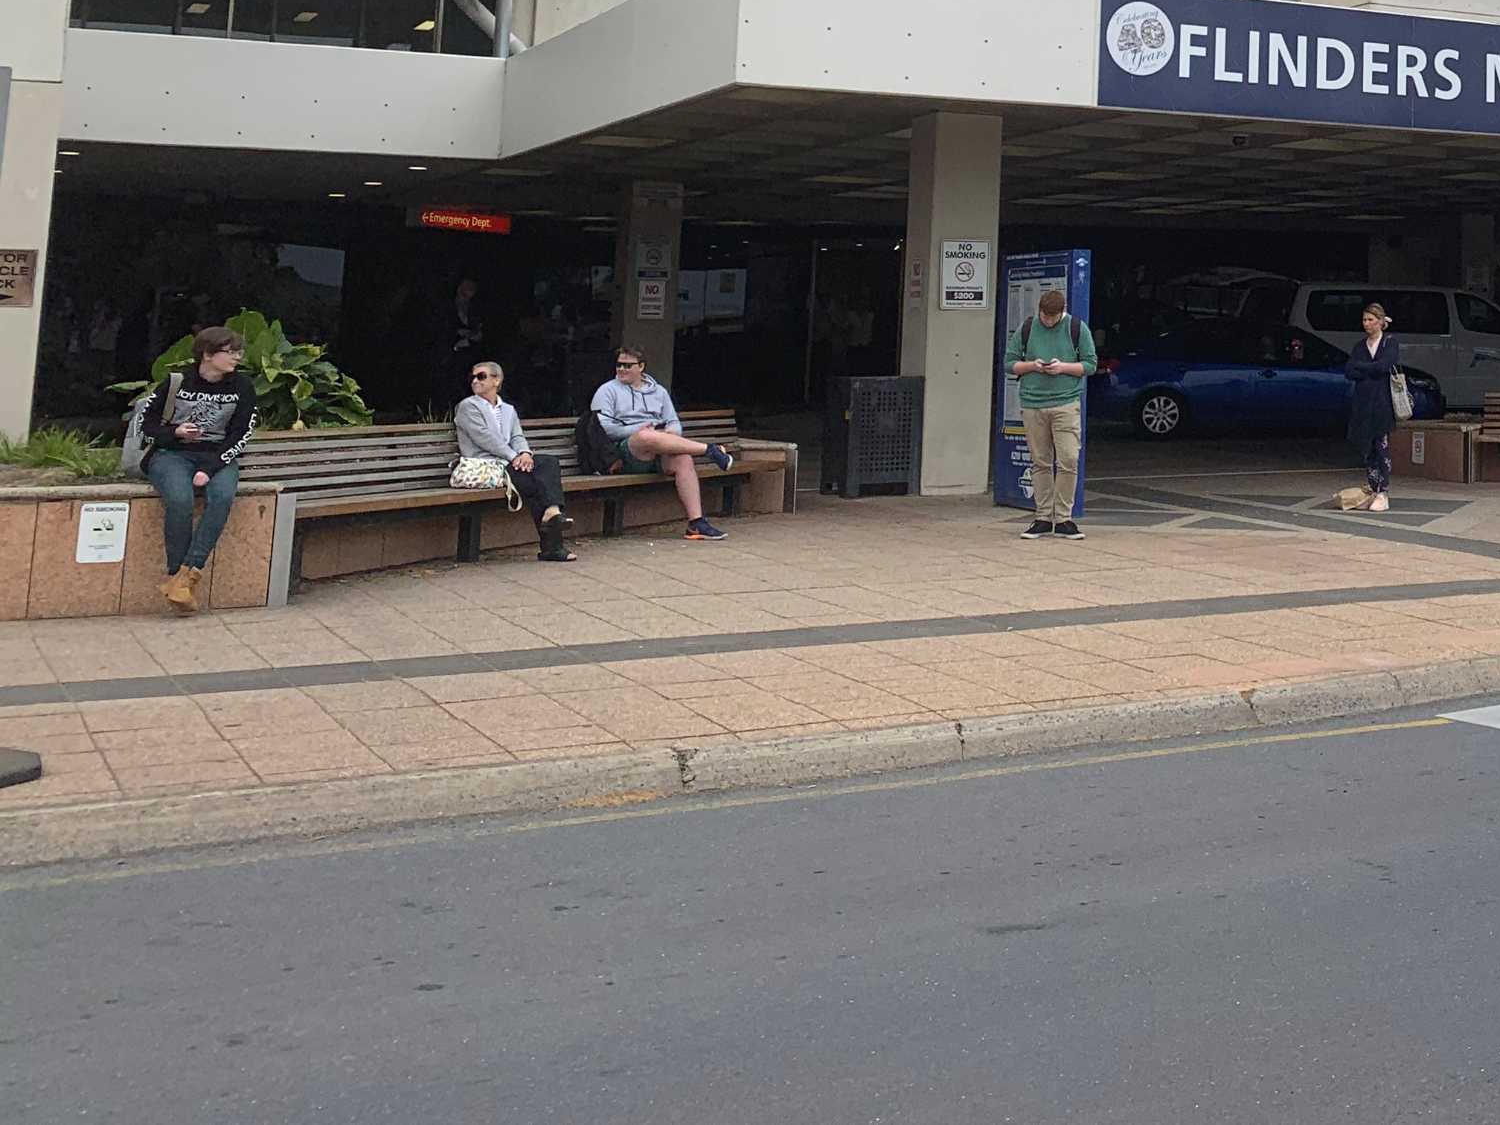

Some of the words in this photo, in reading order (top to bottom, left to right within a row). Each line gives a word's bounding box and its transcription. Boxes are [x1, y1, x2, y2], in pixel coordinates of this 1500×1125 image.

[1117, 18, 1165, 52] 40
[1178, 24, 1462, 101] FLINDERS
[429, 212, 470, 227] Emergency
[471, 216, 492, 229] Dept.
[958, 243, 973, 251] NO
[0, 253, 28, 263] OR
[944, 250, 986, 260] SMOKING
[953, 291, 975, 300] $200
[177, 388, 196, 400] JOY
[197, 392, 240, 403] DIVISION
